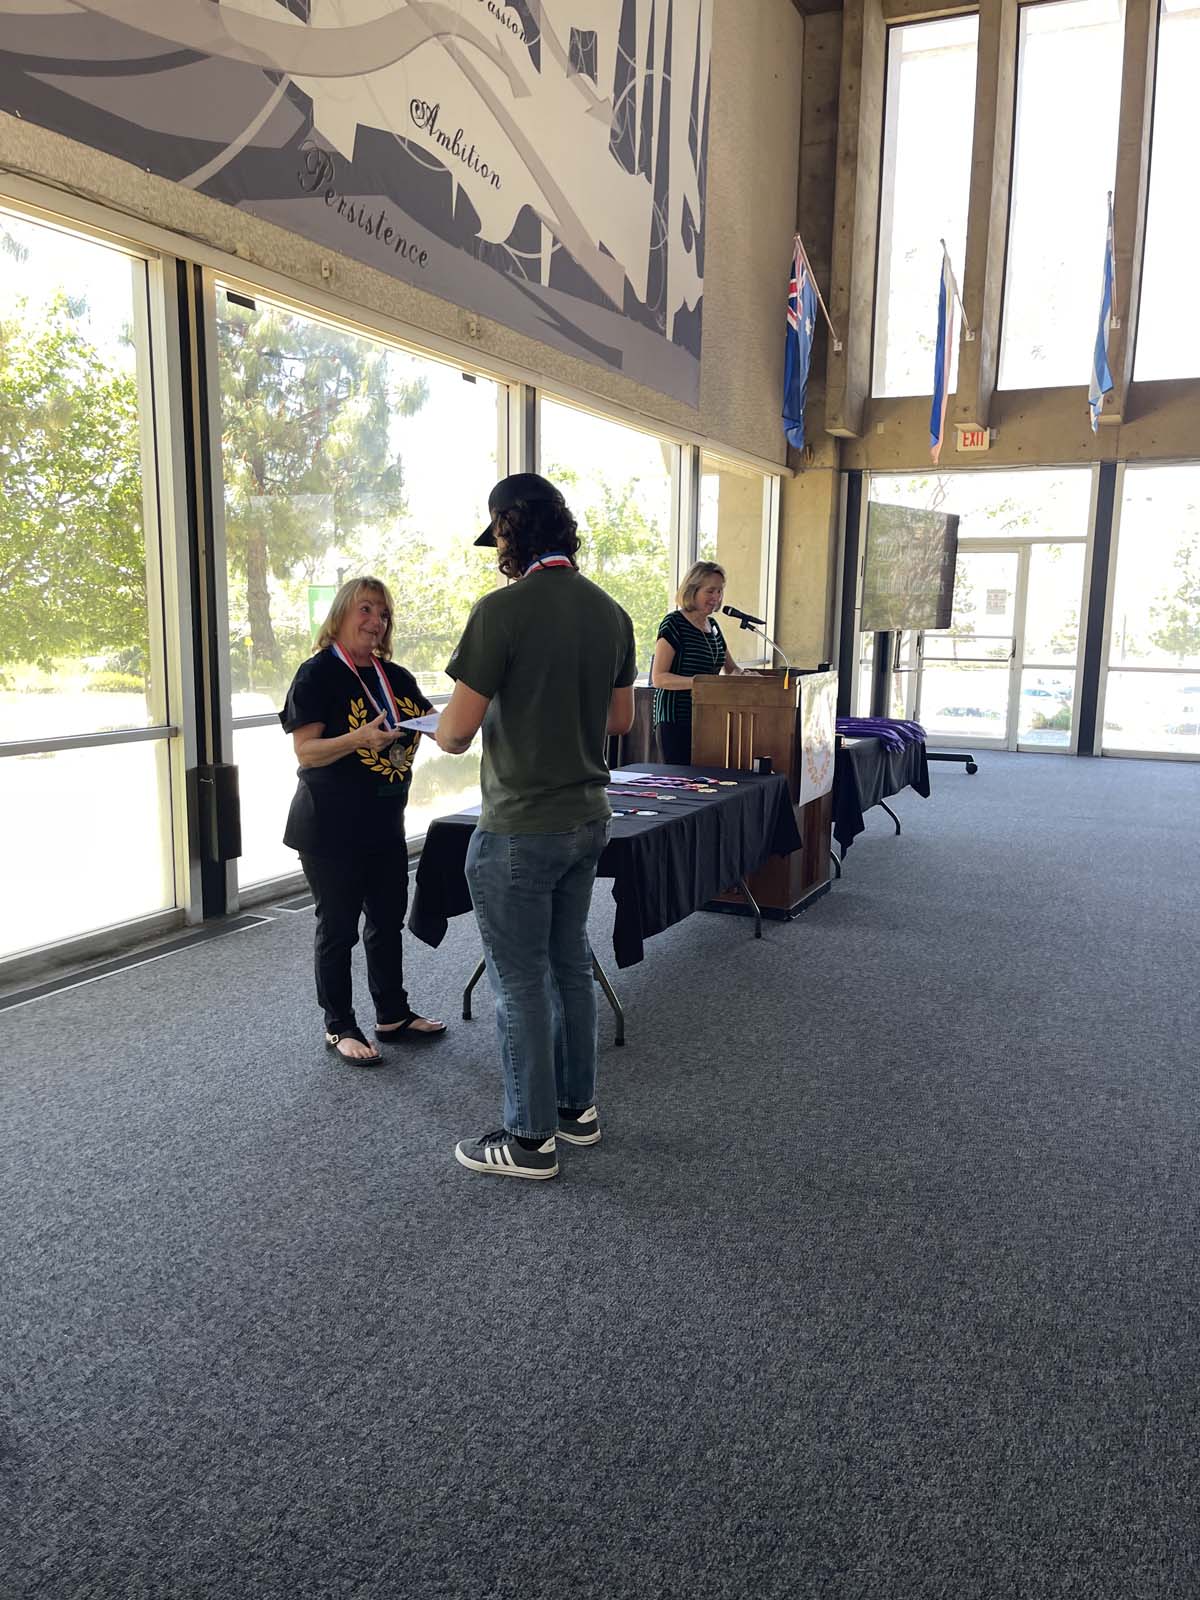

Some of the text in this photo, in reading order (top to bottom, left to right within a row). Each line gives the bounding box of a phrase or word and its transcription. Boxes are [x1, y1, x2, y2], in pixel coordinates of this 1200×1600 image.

[477, 0, 528, 45] assion
[410, 98, 501, 190] Ambition
[297, 146, 429, 269] Persistence
[962, 430, 985, 448] EXIT
